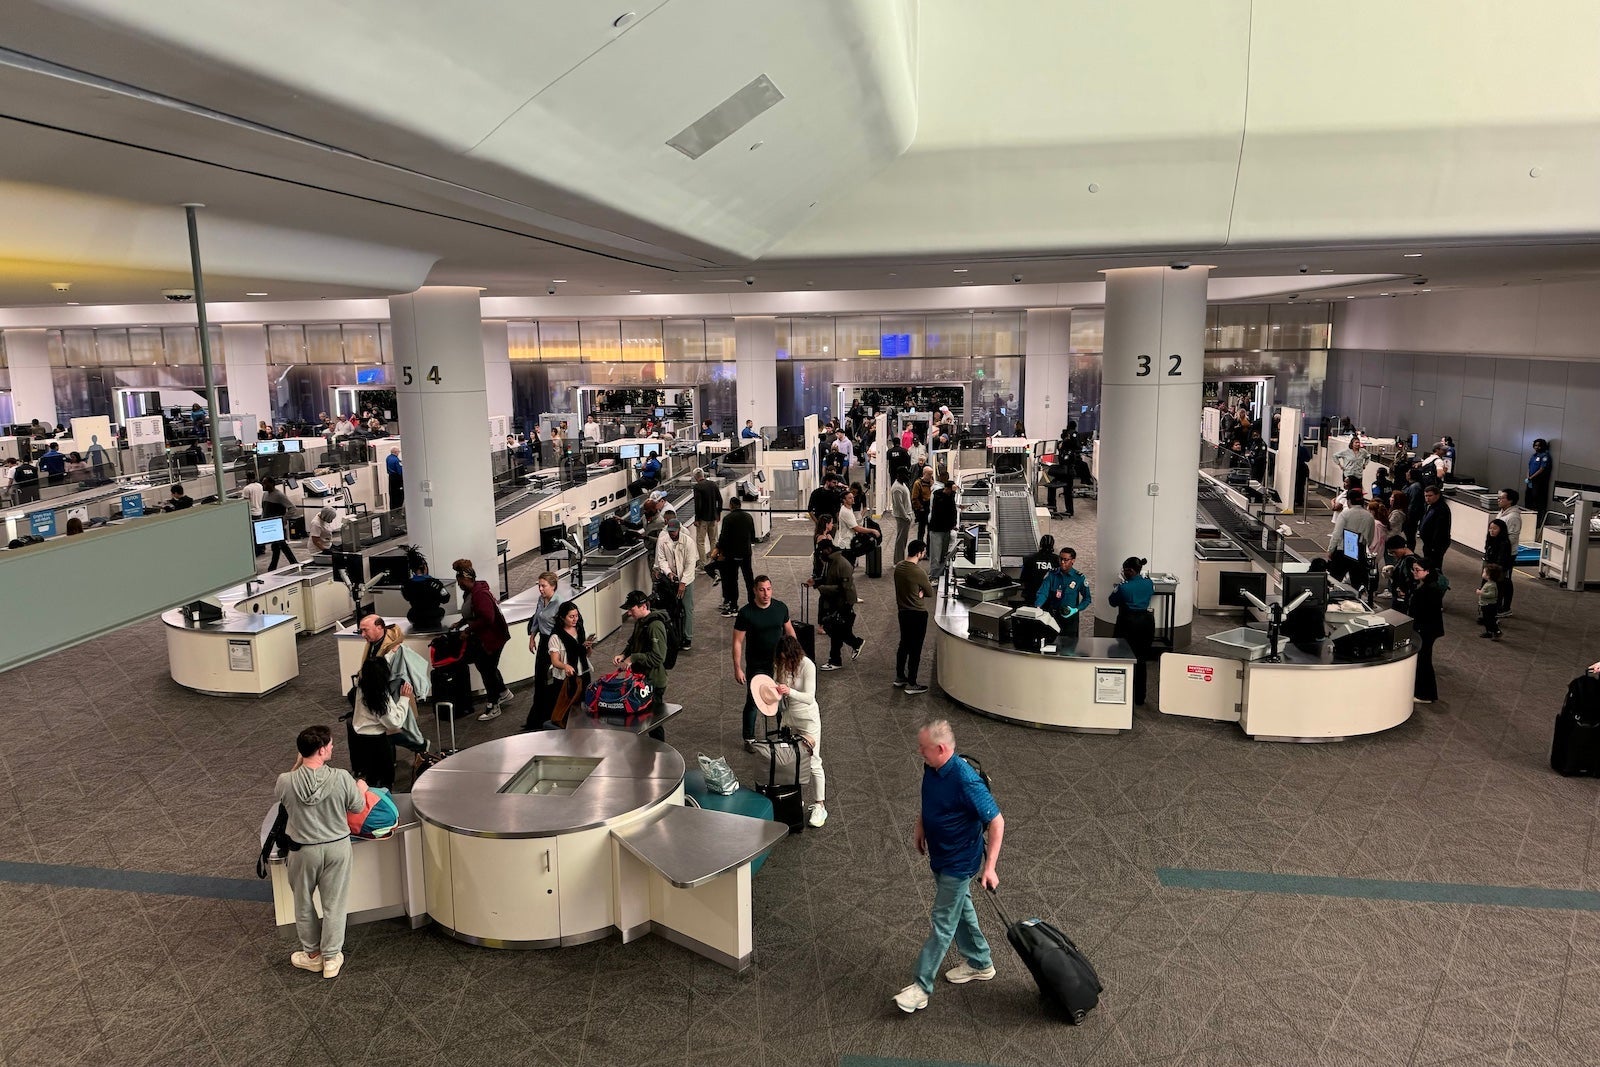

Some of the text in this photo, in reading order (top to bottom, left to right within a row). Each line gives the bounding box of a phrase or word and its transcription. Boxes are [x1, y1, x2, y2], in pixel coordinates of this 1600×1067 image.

[426, 365, 442, 385] 4
[1136, 354, 1151, 376] 3
[1168, 354, 1182, 376] 2
[403, 366, 413, 385] 5
[1036, 561, 1052, 570] TSA
